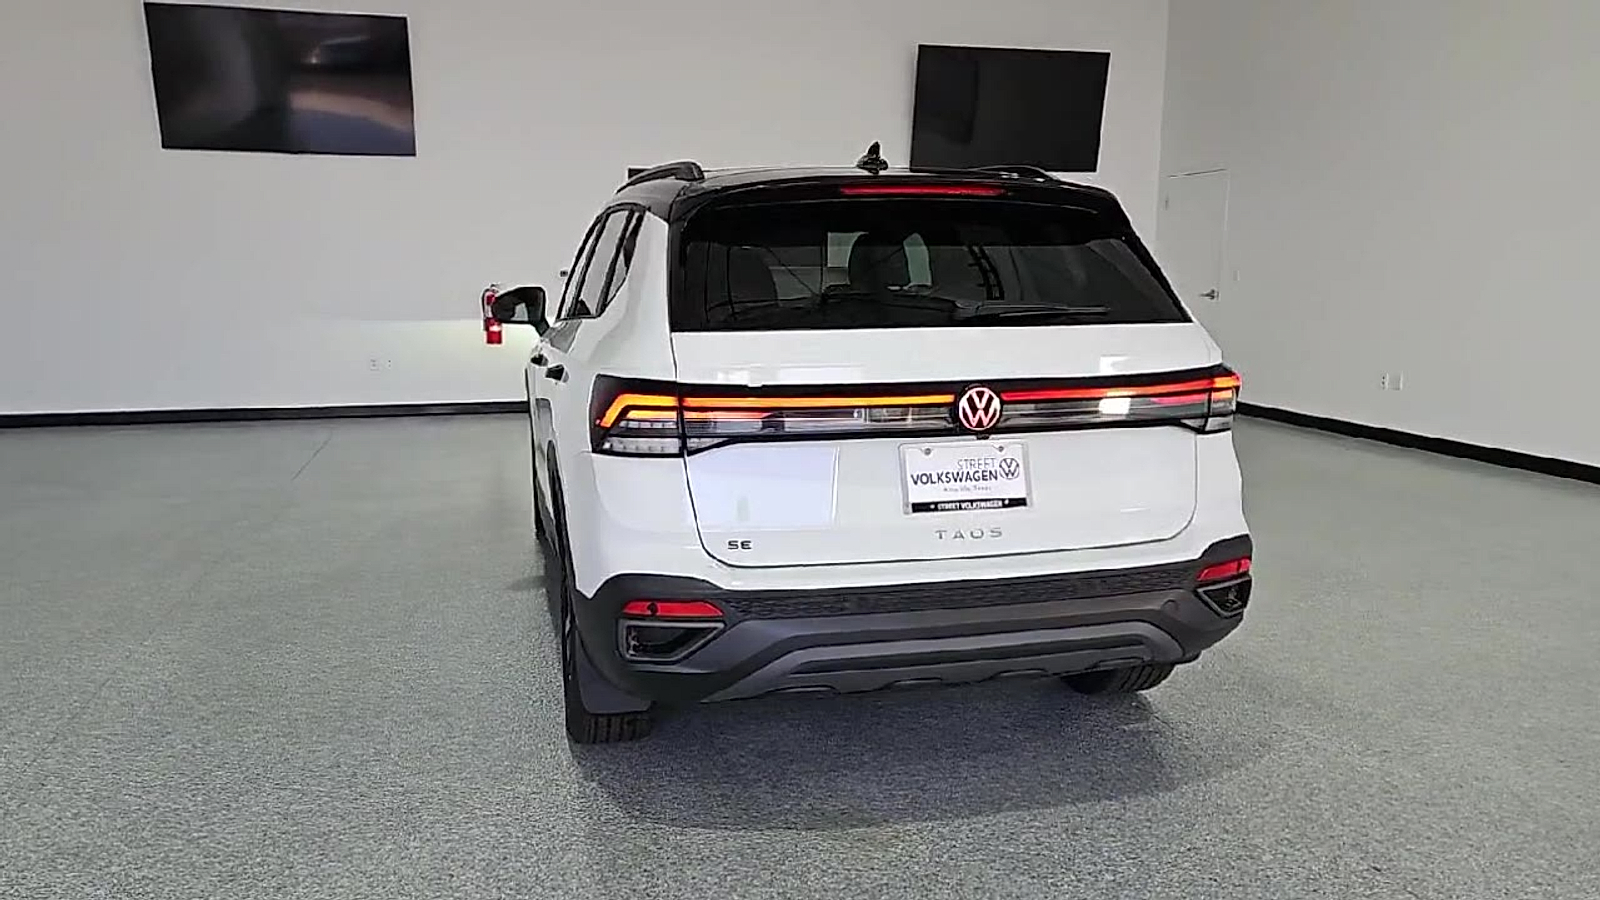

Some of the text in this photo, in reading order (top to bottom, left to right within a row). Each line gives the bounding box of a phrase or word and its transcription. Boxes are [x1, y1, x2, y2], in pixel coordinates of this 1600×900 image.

[957, 457, 996, 470] STREET
[910, 469, 998, 485] VOLKSWAGEN
[935, 527, 1003, 540] TAOS
[727, 540, 752, 550] SE
